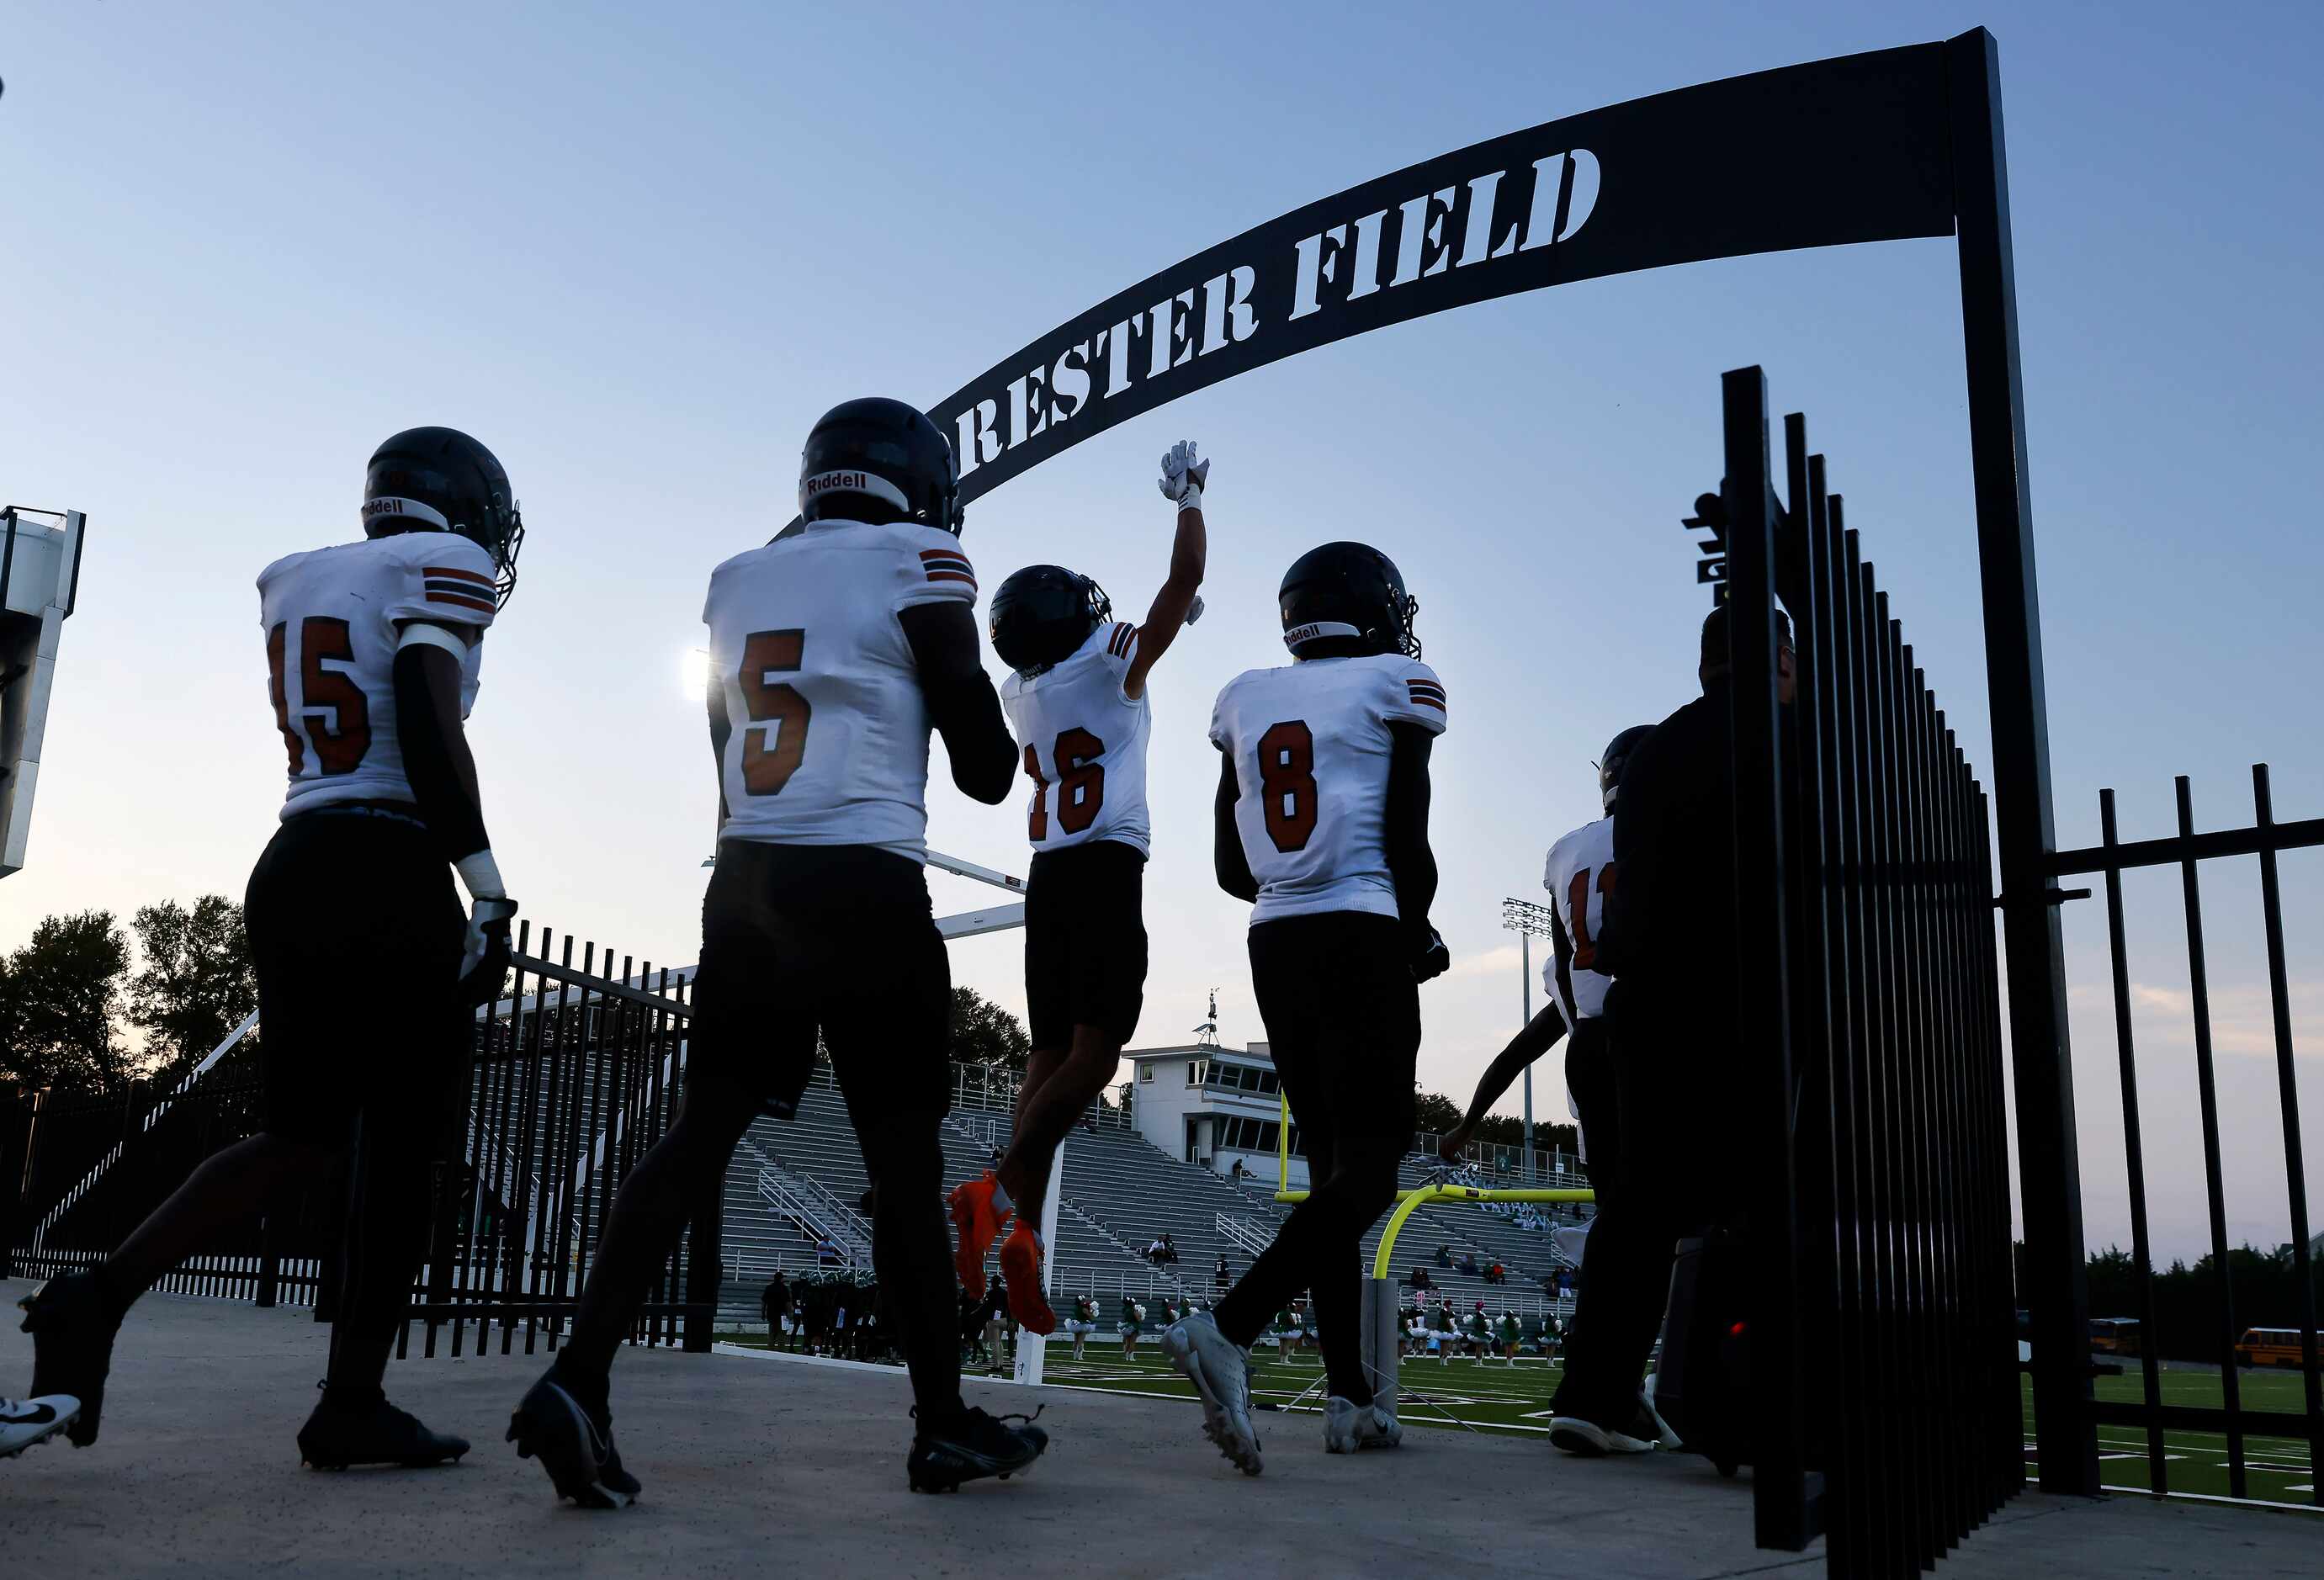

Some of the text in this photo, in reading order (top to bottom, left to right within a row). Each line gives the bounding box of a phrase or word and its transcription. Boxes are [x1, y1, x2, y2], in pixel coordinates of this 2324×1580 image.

[1288, 148, 1601, 321] FIELD
[807, 473, 866, 496] Riddell
[267, 616, 372, 775] 15
[739, 628, 811, 796] 5
[1024, 726, 1106, 841] 16
[1257, 719, 1318, 853] 8
